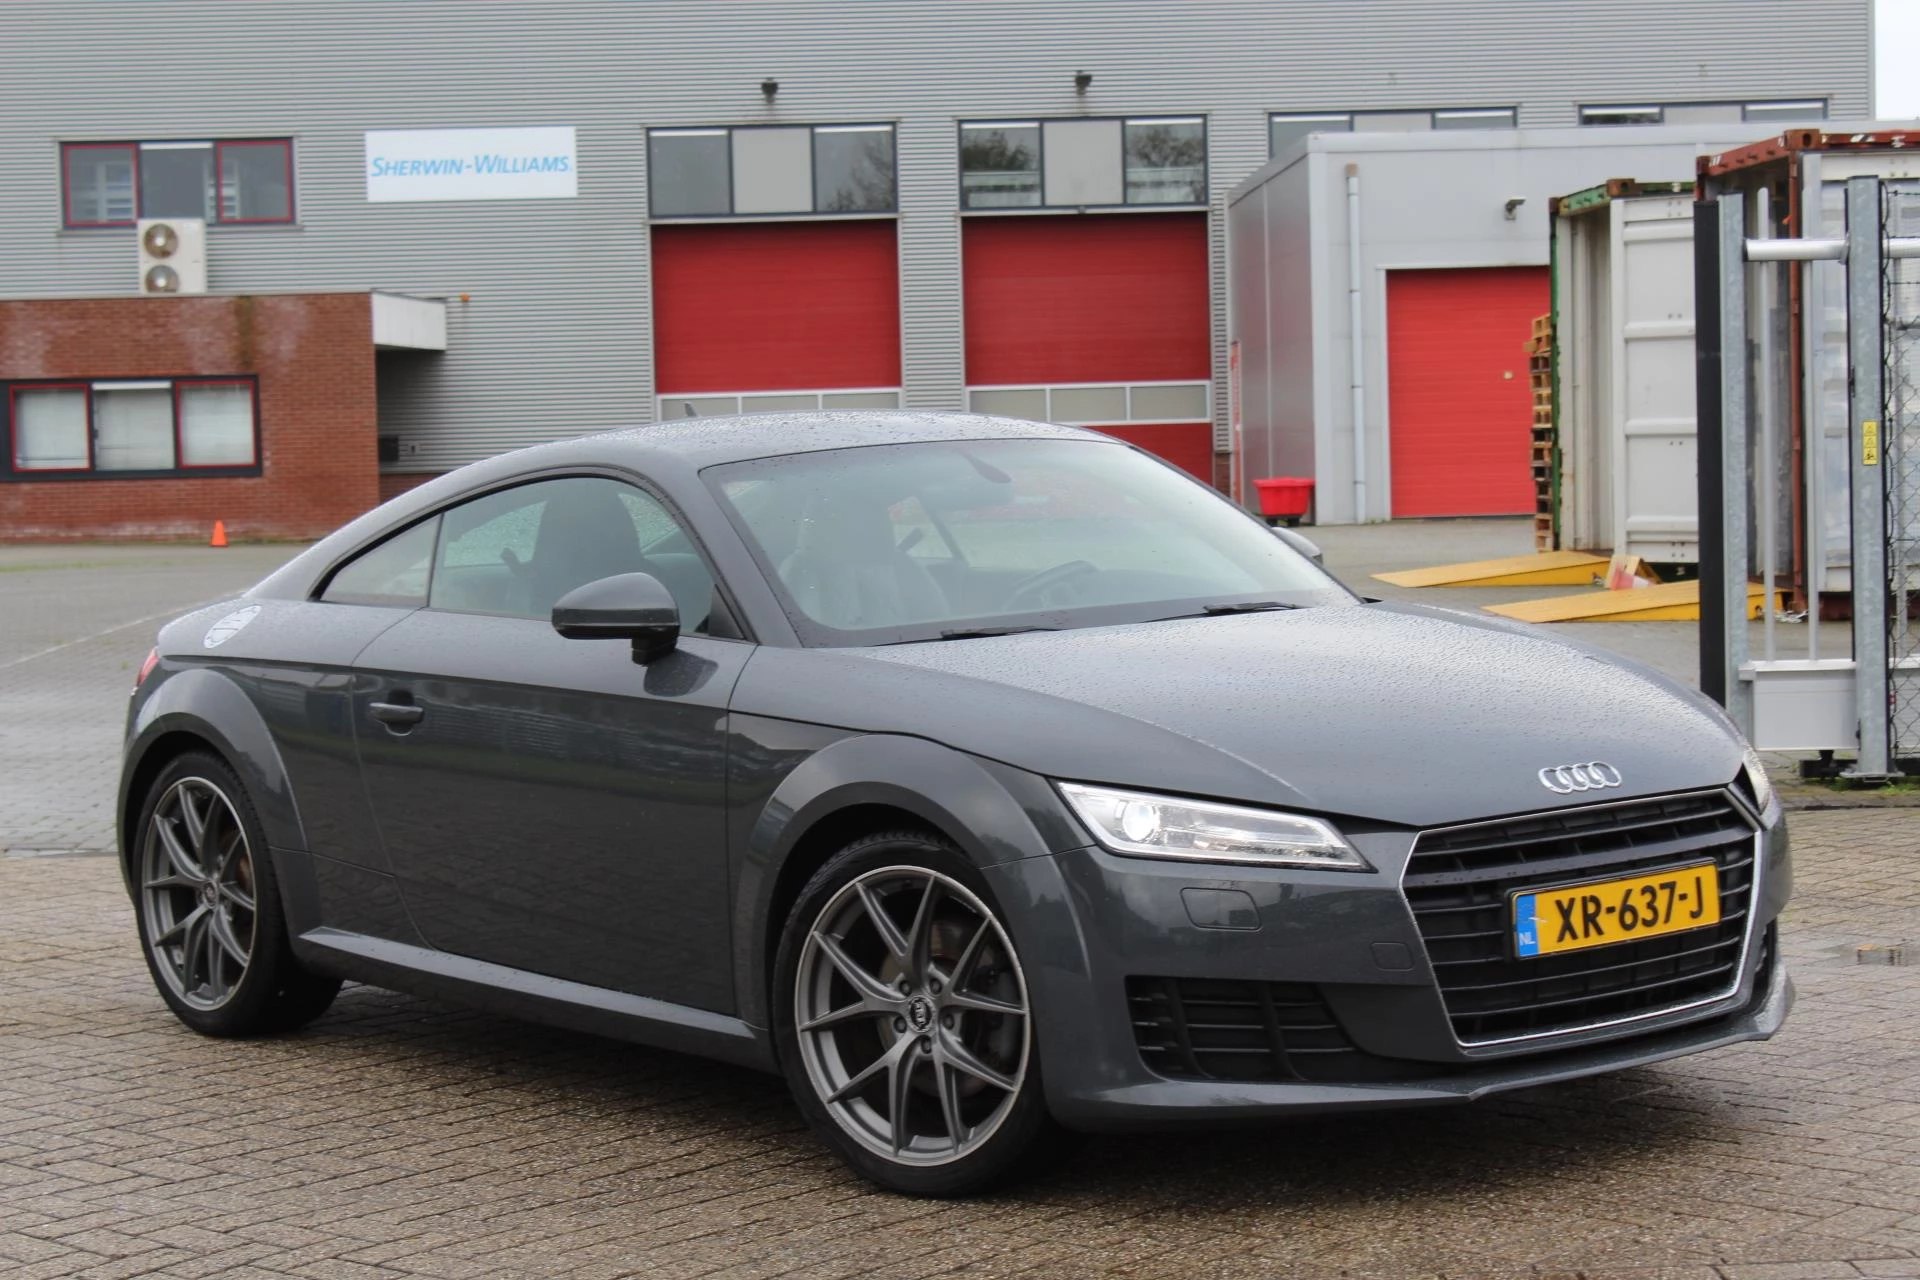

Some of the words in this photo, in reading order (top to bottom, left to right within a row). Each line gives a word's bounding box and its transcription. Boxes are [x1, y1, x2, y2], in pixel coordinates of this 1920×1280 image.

[371, 154, 570, 177] SHERWIN-WILLIAMS
[1555, 876, 1703, 943] XR-637-J
[1519, 931, 1536, 946] NL
